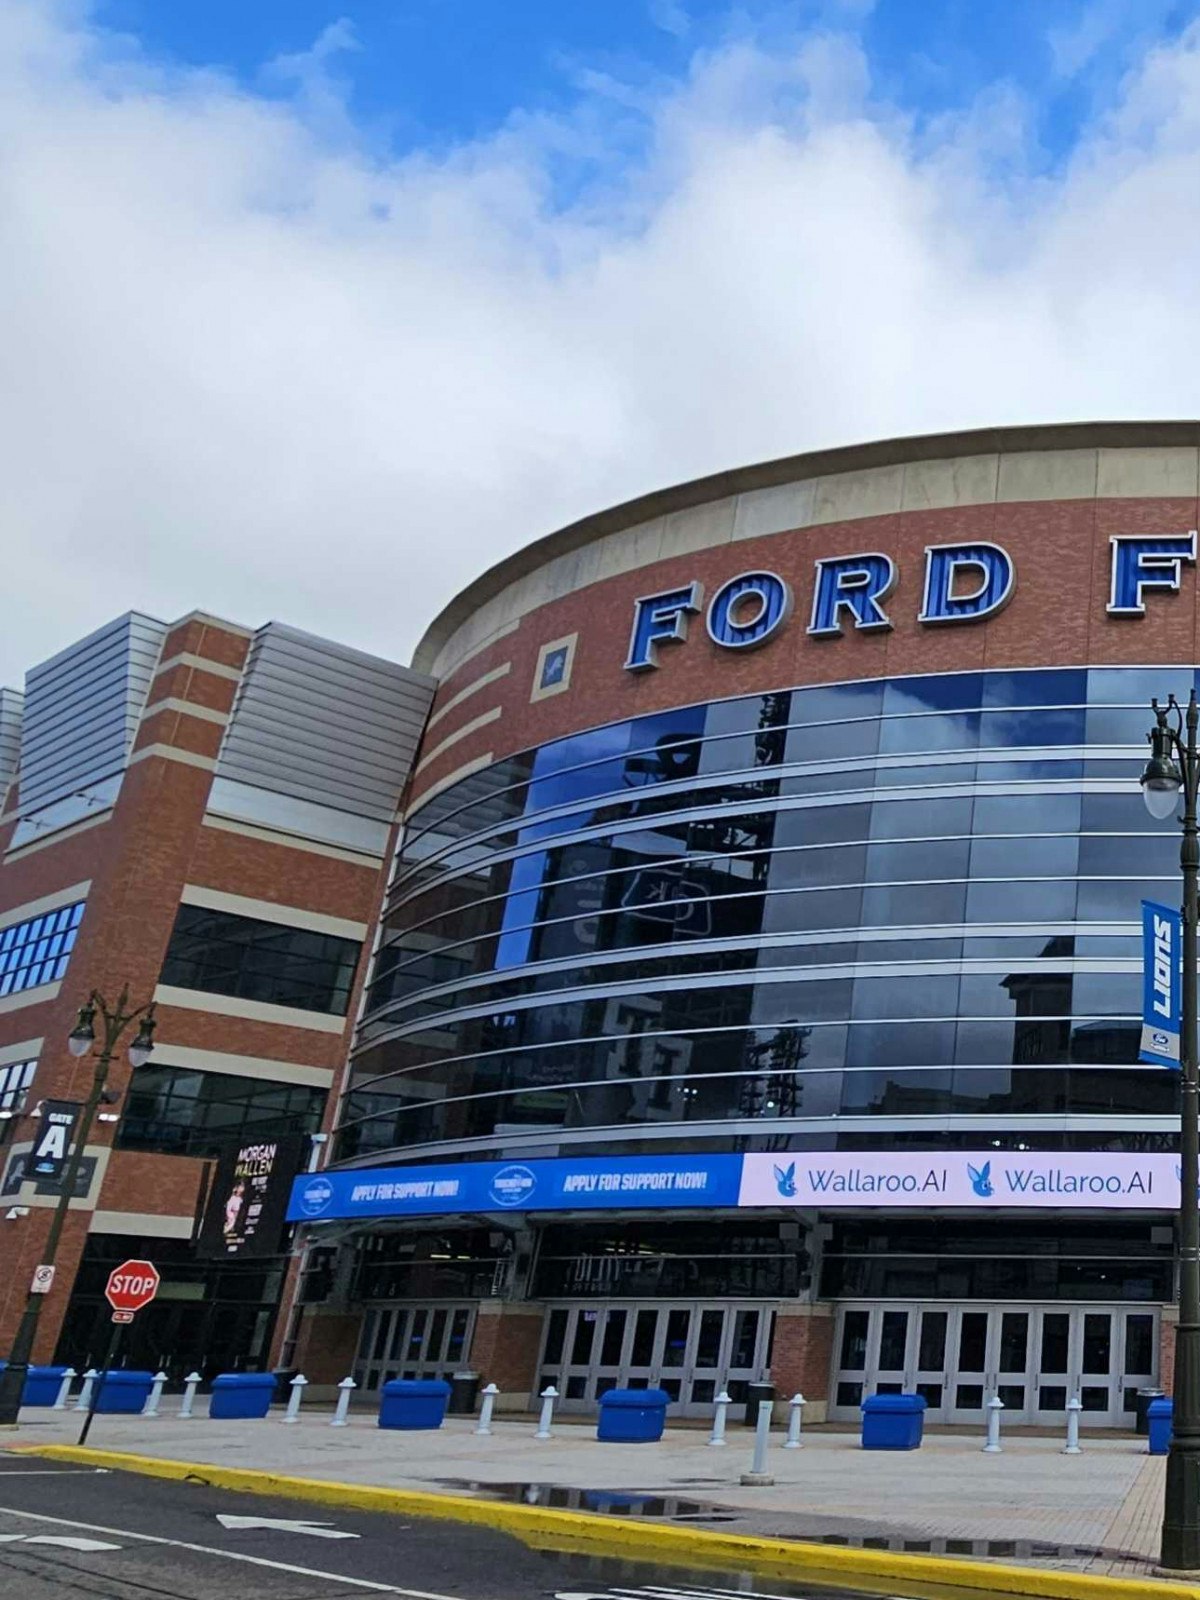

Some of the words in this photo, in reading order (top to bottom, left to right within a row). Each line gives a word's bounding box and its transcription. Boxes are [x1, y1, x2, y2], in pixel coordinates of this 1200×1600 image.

[623, 540, 1018, 672] FORD
[1153, 914, 1171, 1019] LIONS
[48, 1113, 73, 1124] GATE
[36, 1125, 66, 1159] A
[237, 1144, 277, 1162] MORGAN
[351, 1184, 375, 1201] APPLY
[375, 1183, 394, 1199] FOR
[393, 1181, 434, 1199] SUPPORT
[563, 1174, 598, 1192] APPLY
[598, 1174, 622, 1191] FOR
[621, 1173, 675, 1190] SUPPORT
[674, 1172, 708, 1189] NOW!
[809, 1168, 947, 1194] Wallaroo.AI
[1005, 1168, 1153, 1195] Wallaroo.AI
[110, 1275, 155, 1296] STOP
